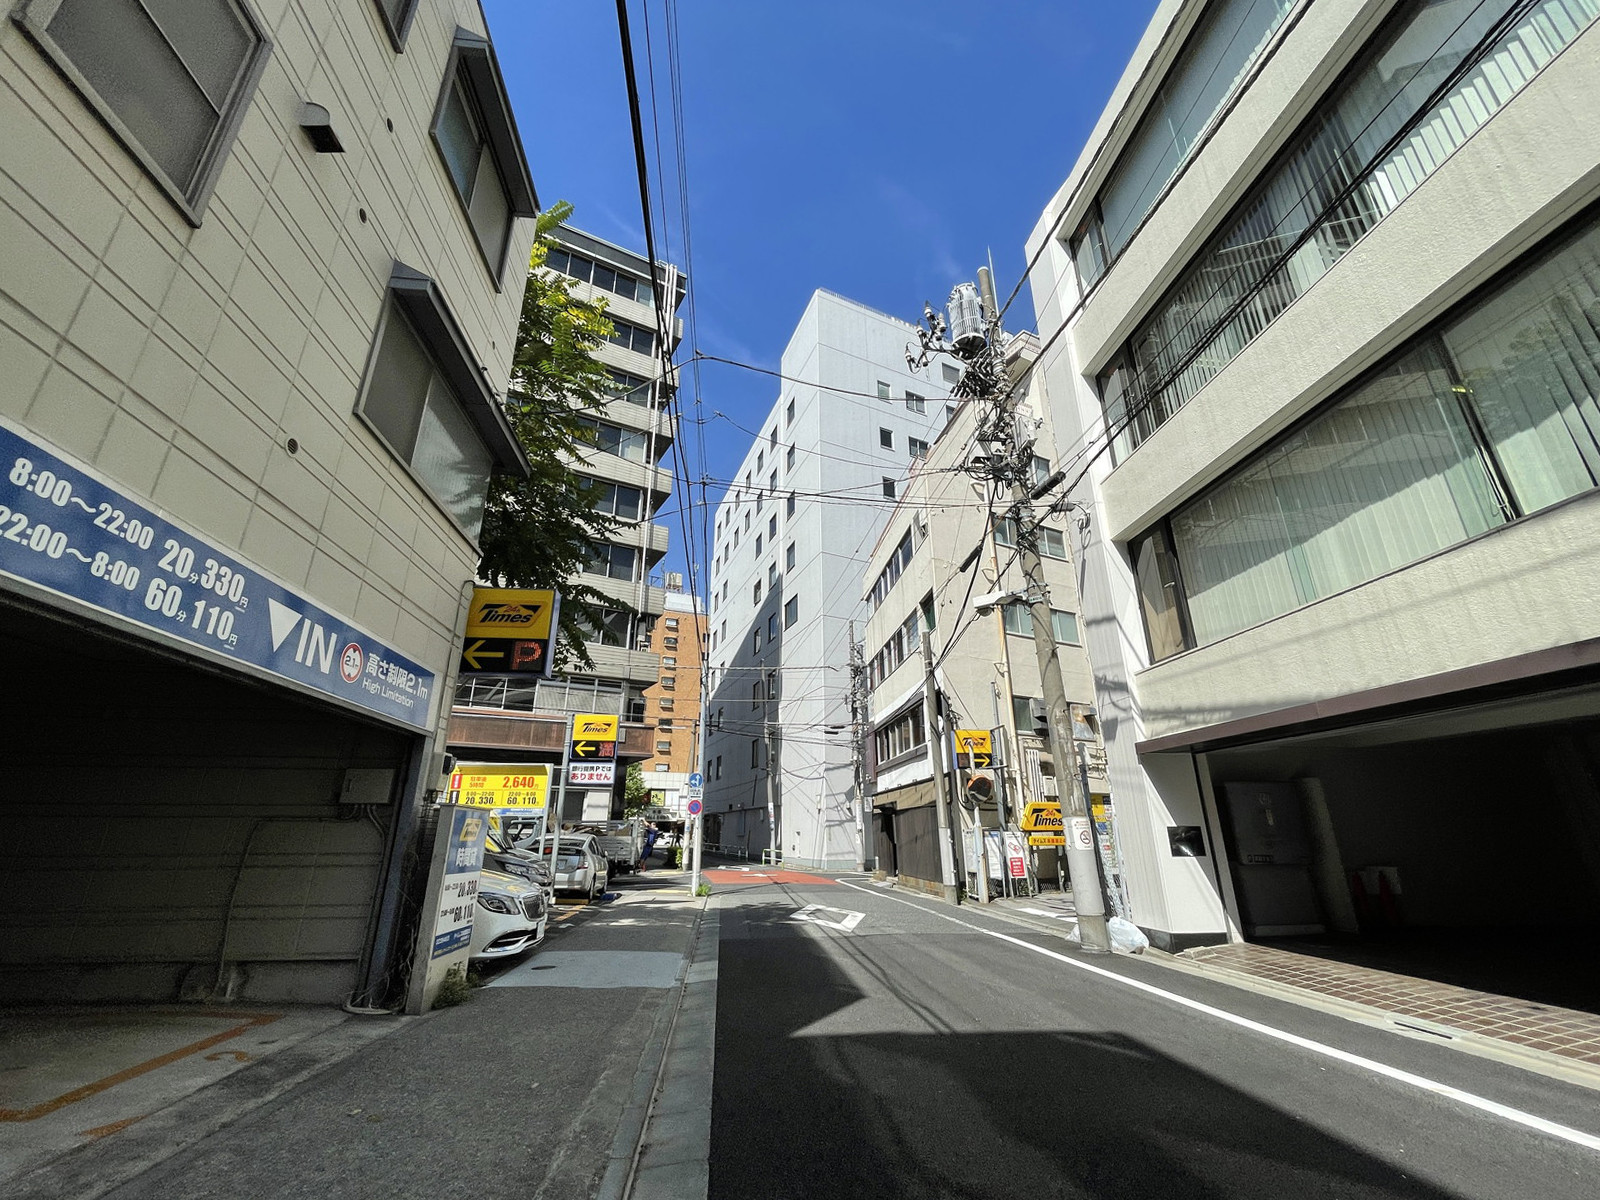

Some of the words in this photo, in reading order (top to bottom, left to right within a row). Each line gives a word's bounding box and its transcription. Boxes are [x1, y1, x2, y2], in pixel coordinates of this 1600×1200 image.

[478, 603, 540, 624] Times
[294, 617, 338, 675] IN
[511, 641, 542, 670] P
[361, 677, 381, 696] High
[381, 686, 414, 709] Limitation
[582, 722, 612, 733] Times
